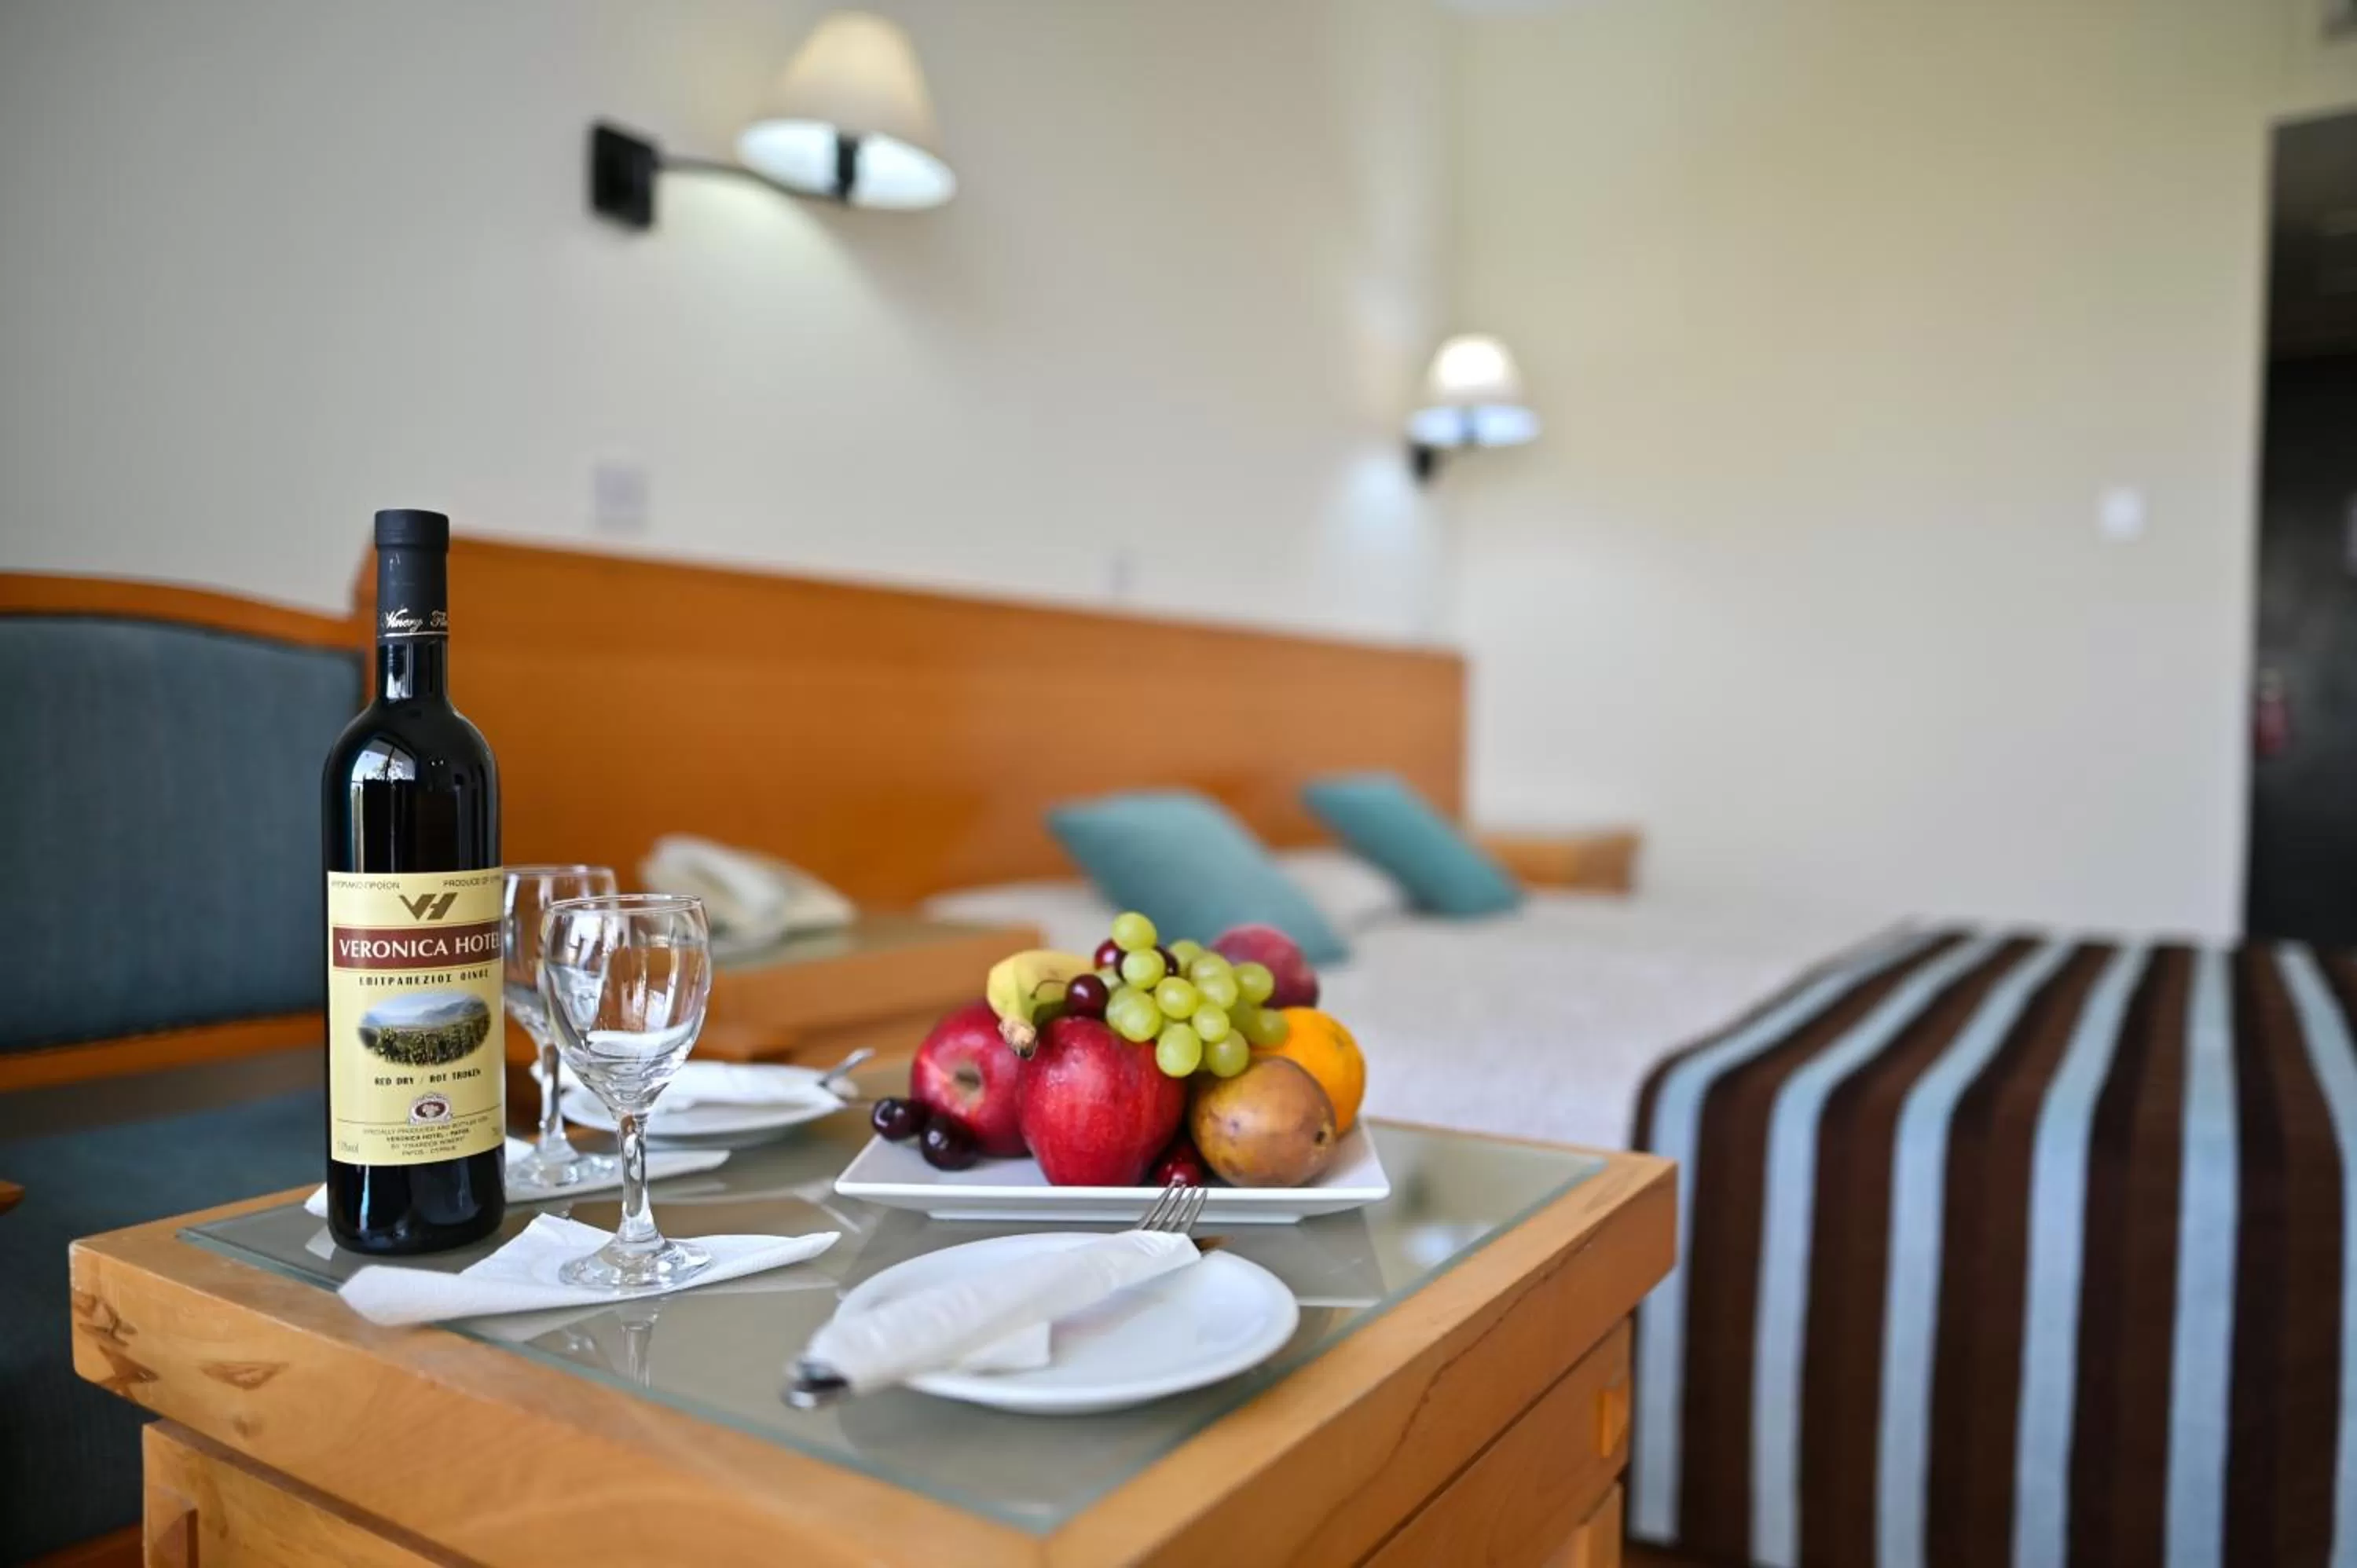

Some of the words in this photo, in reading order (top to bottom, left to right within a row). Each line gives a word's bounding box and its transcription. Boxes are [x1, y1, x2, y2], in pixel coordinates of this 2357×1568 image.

[442, 877, 480, 887] PRODUCE
[339, 939, 449, 958] VERONICA
[455, 932, 500, 954] HOTEL
[375, 1076, 392, 1086] RED
[397, 1077, 414, 1086] DRY
[430, 1074, 447, 1083] ROT
[420, 1132, 444, 1141] HOTEL
